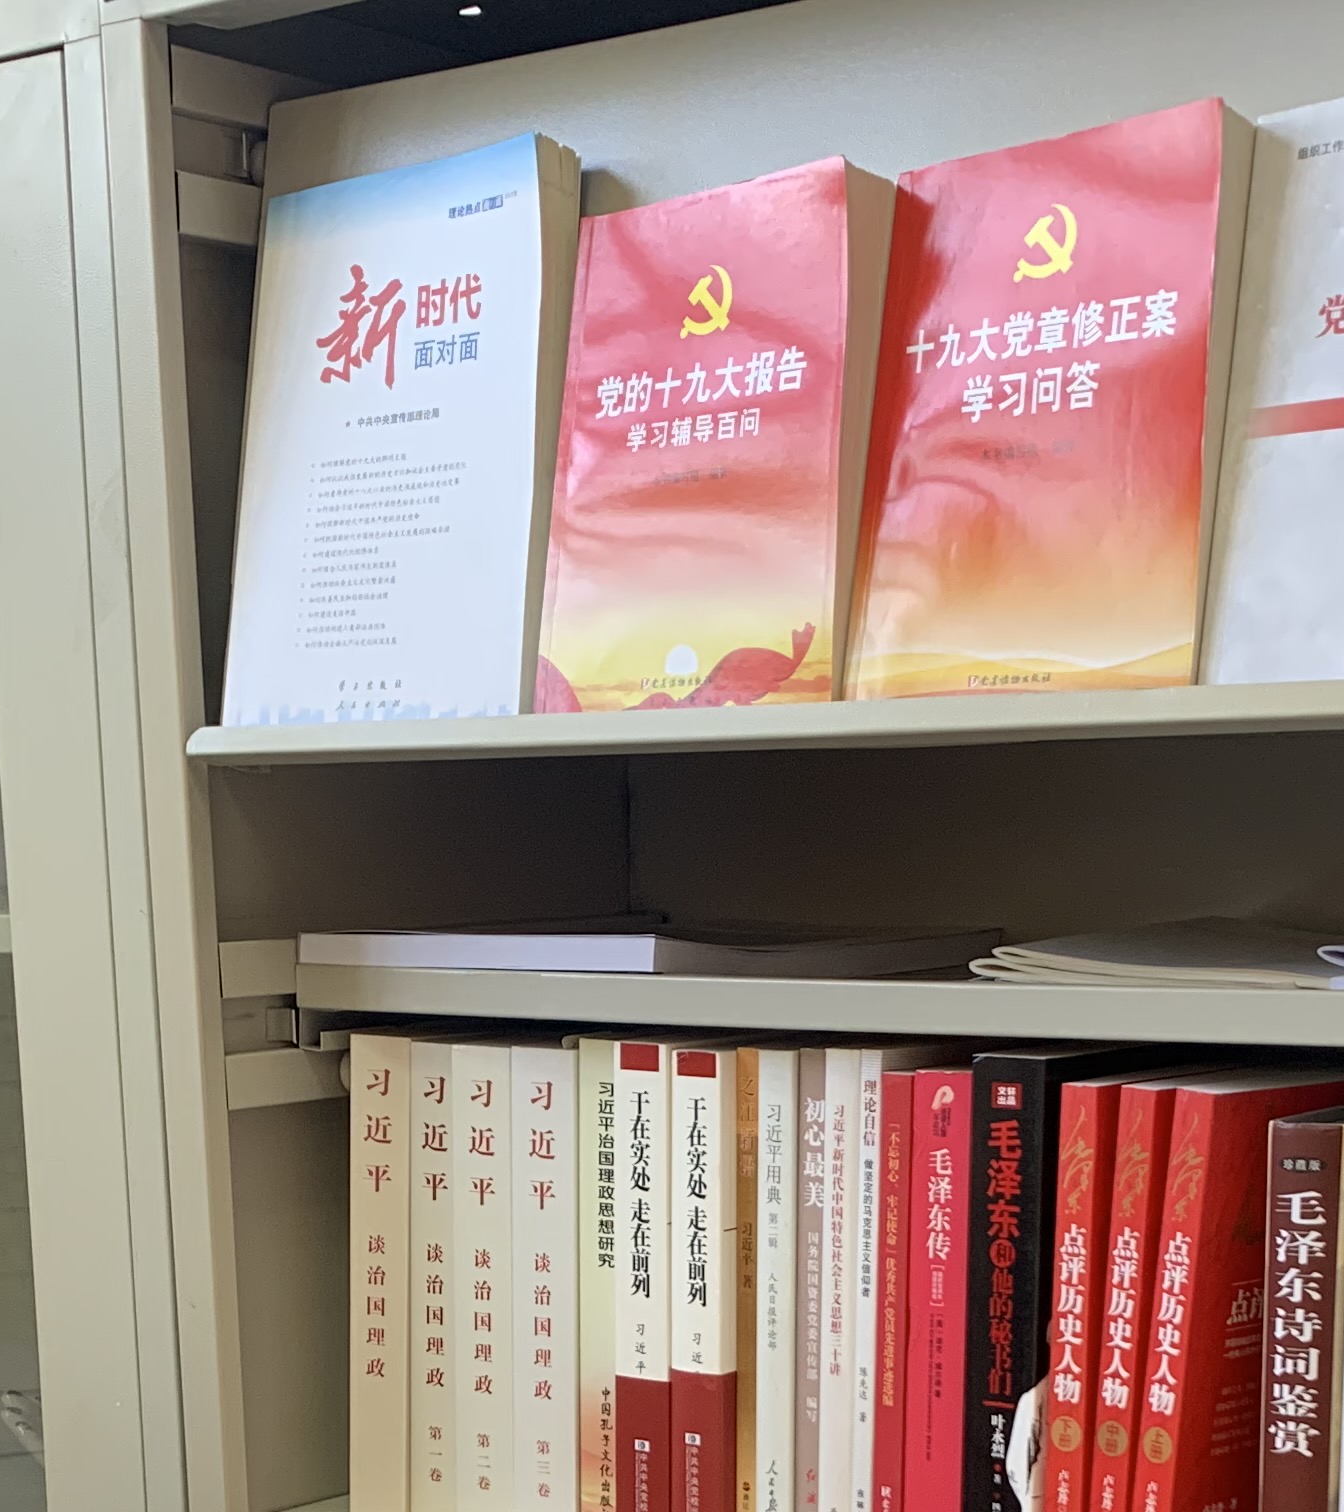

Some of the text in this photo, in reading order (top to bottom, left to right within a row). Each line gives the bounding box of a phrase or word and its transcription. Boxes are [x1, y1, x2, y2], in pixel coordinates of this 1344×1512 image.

[316, 265, 482, 389] 新 时代
[414, 332, 479, 371] 面对面
[596, 345, 806, 421] 党的十九大报告
[905, 289, 1179, 375] 十九大党章修正案
[961, 360, 1101, 424] 学习问答
[357, 408, 440, 428] 中共中央宣传部理论局
[626, 408, 759, 450] 学习辅导百问
[597, 1082, 615, 1268] 习近平治国理政思想研究
[766, 1103, 782, 1249] 习近平用典 第二辑
[803, 1097, 825, 1208] 初心最美
[863, 1080, 877, 1147] 理论自信
[1283, 1158, 1321, 1171] 珍藏版
[363, 1068, 392, 1379] 习近平 谈治国理政
[630, 1090, 651, 1374] 干在实处 走在前列 习近平
[686, 1097, 708, 1308] 干在实处 走在前列
[742, 1222, 754, 1266] 习近平
[829, 1105, 846, 1377] 习近平新时代中国特色社会主义思想三十讲
[861, 1159, 874, 1298] 做坚定的马克思主义信仰者
[926, 1148, 954, 1261] 毛泽东传
[986, 1120, 1023, 1396] 毛泽东和他的秘书们
[421, 1076, 449, 1483] 习近平 谈治国理政 第一卷
[468, 1079, 496, 1491] 习近平 谈治国理政 第二卷
[528, 1080, 556, 1499] 习近平 谈治国理政 第三卷
[1053, 1223, 1088, 1404] 点评历史人物
[1101, 1226, 1139, 1409] 点评历史人物
[1147, 1231, 1193, 1415] 点评历史人物
[1269, 1191, 1327, 1458] 毛泽东诗词鉴赏
[990, 1413, 1006, 1459] 叶永烈
